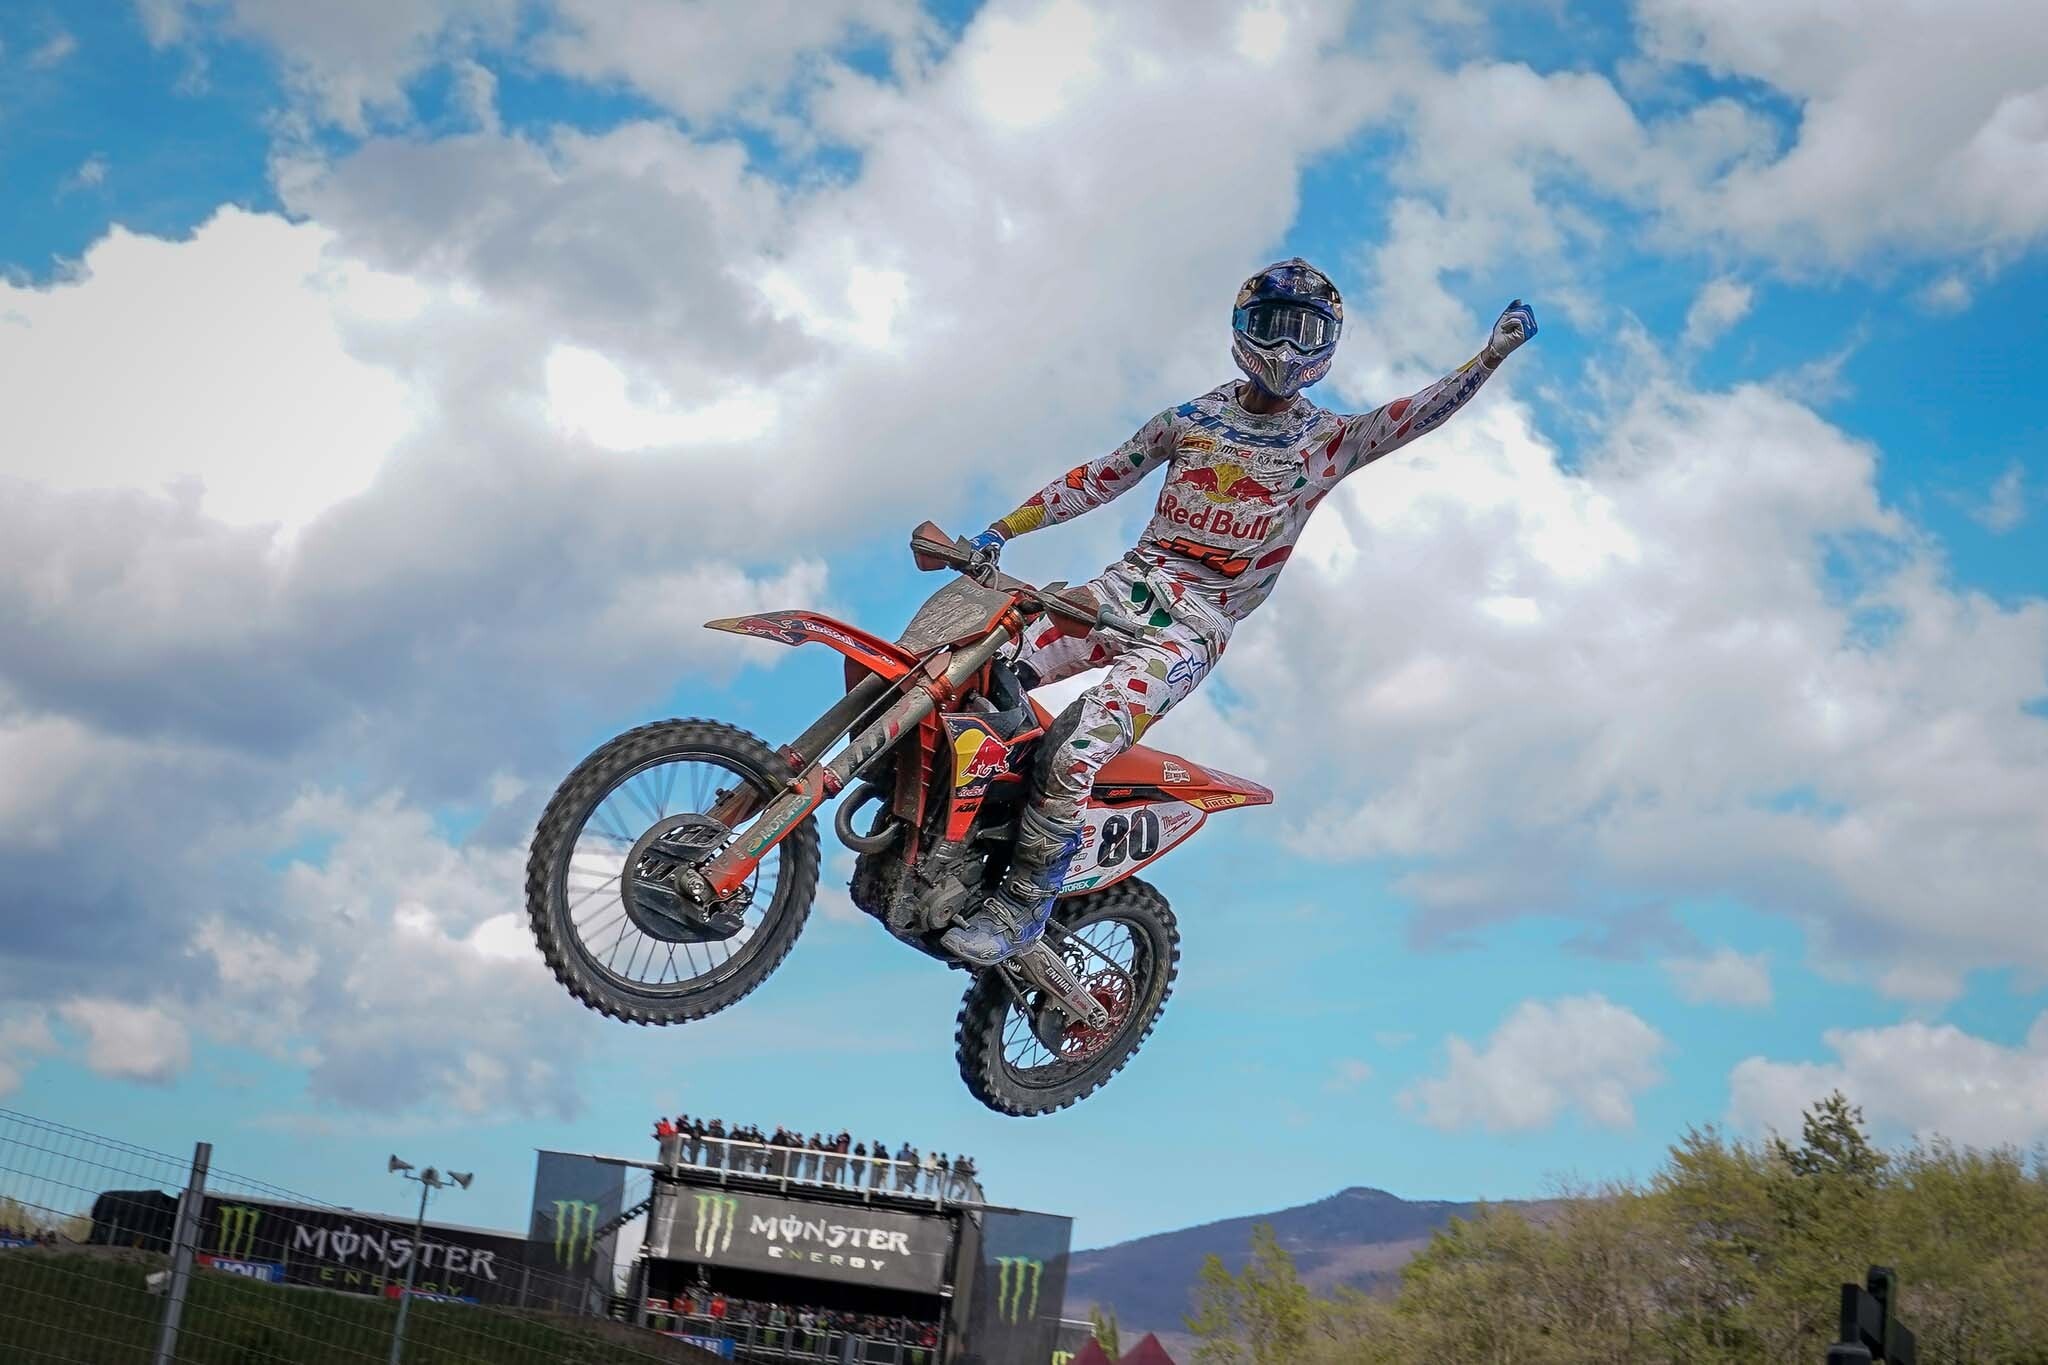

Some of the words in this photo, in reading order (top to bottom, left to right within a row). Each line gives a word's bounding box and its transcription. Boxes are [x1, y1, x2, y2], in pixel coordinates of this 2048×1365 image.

[1164, 494, 1210, 530] Red
[1209, 509, 1272, 541] Bull
[1202, 795, 1238, 809] PIRELLI
[1097, 810, 1160, 868] 80
[1044, 966, 1073, 994] ENTHAL
[293, 1224, 497, 1281] MONSTER
[750, 1214, 912, 1256] MONSTER
[768, 1246, 886, 1272] ENERGY
